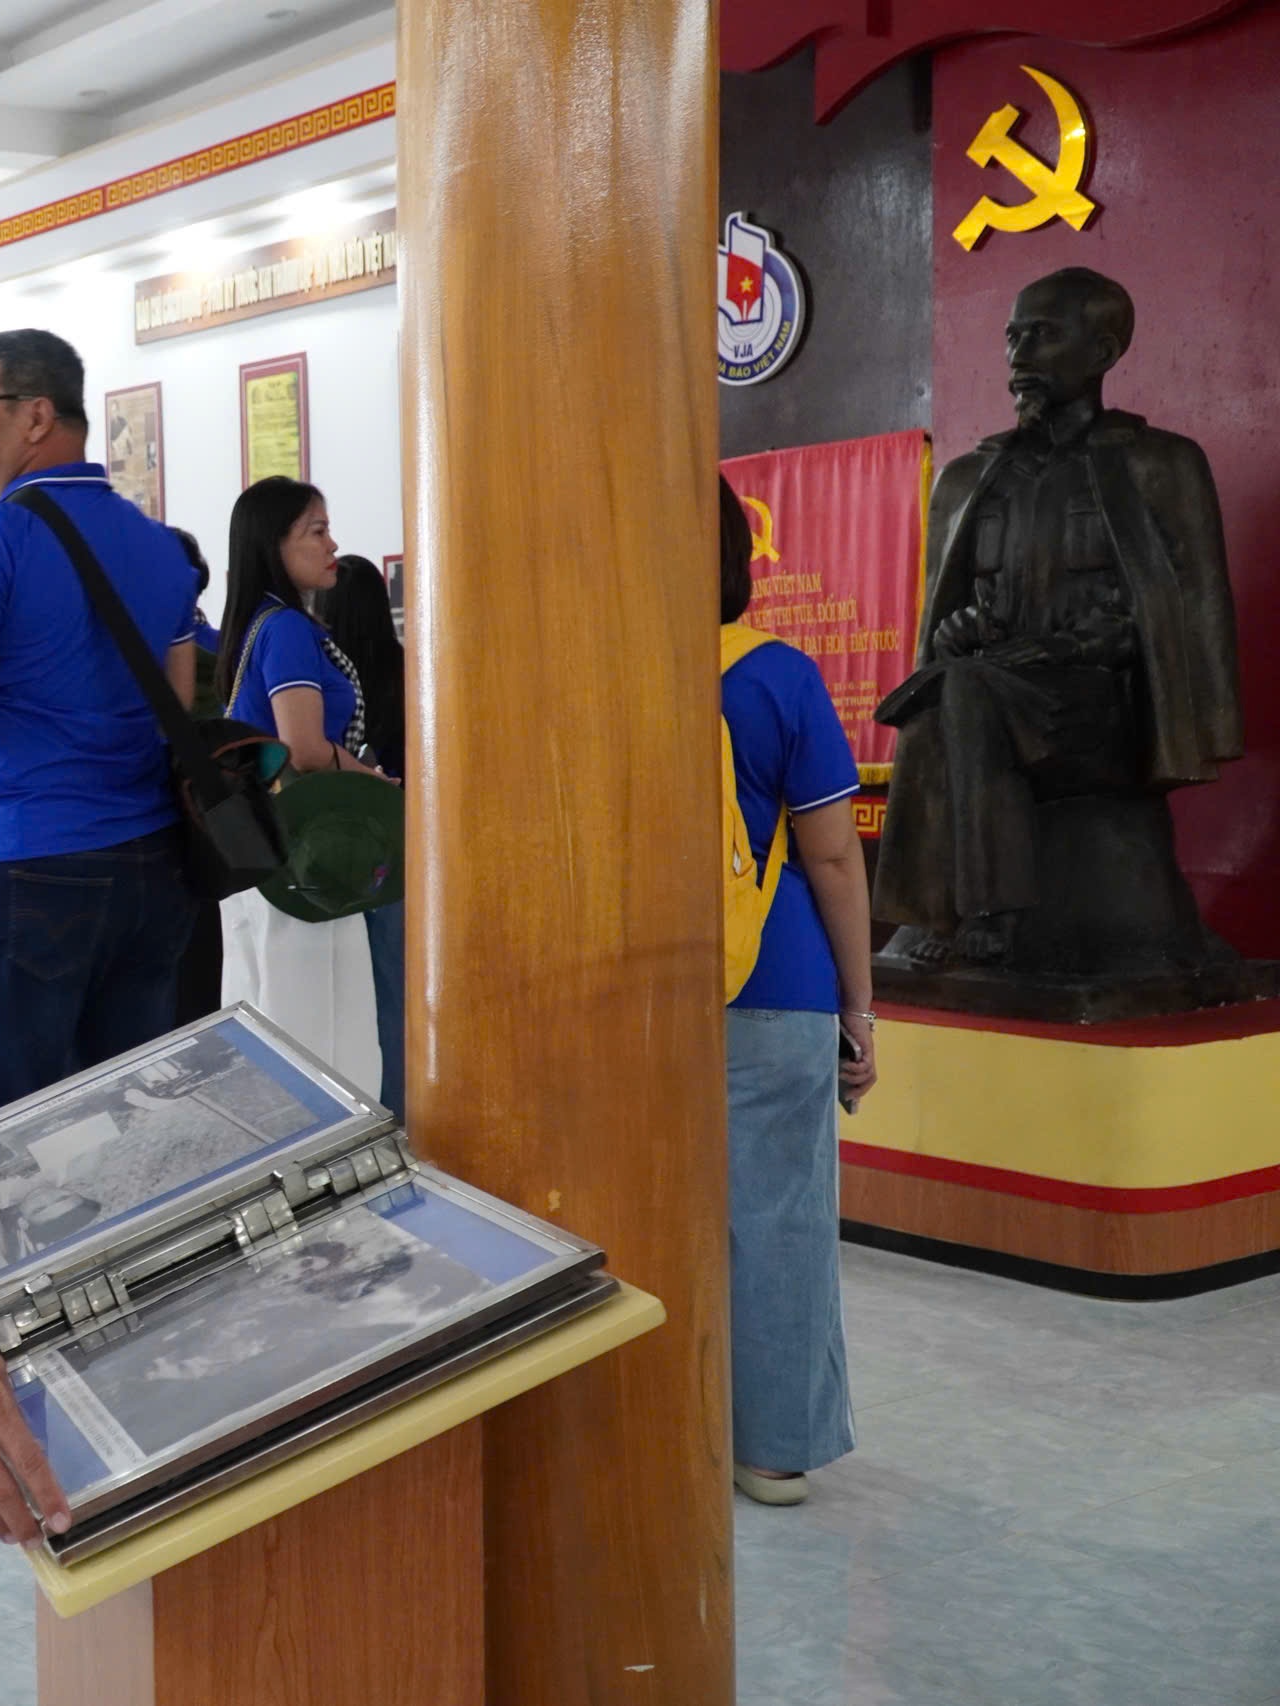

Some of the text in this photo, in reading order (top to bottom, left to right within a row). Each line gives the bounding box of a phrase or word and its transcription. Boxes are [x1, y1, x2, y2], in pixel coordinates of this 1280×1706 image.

[728, 365, 751, 377] BÁO
[774, 320, 791, 351] NAM
[734, 344, 753, 358] VJA
[772, 570, 795, 597] VIỆT
[797, 573, 822, 593] NAM
[774, 602, 793, 626] TRÍ
[818, 593, 836, 623] ĐỔI
